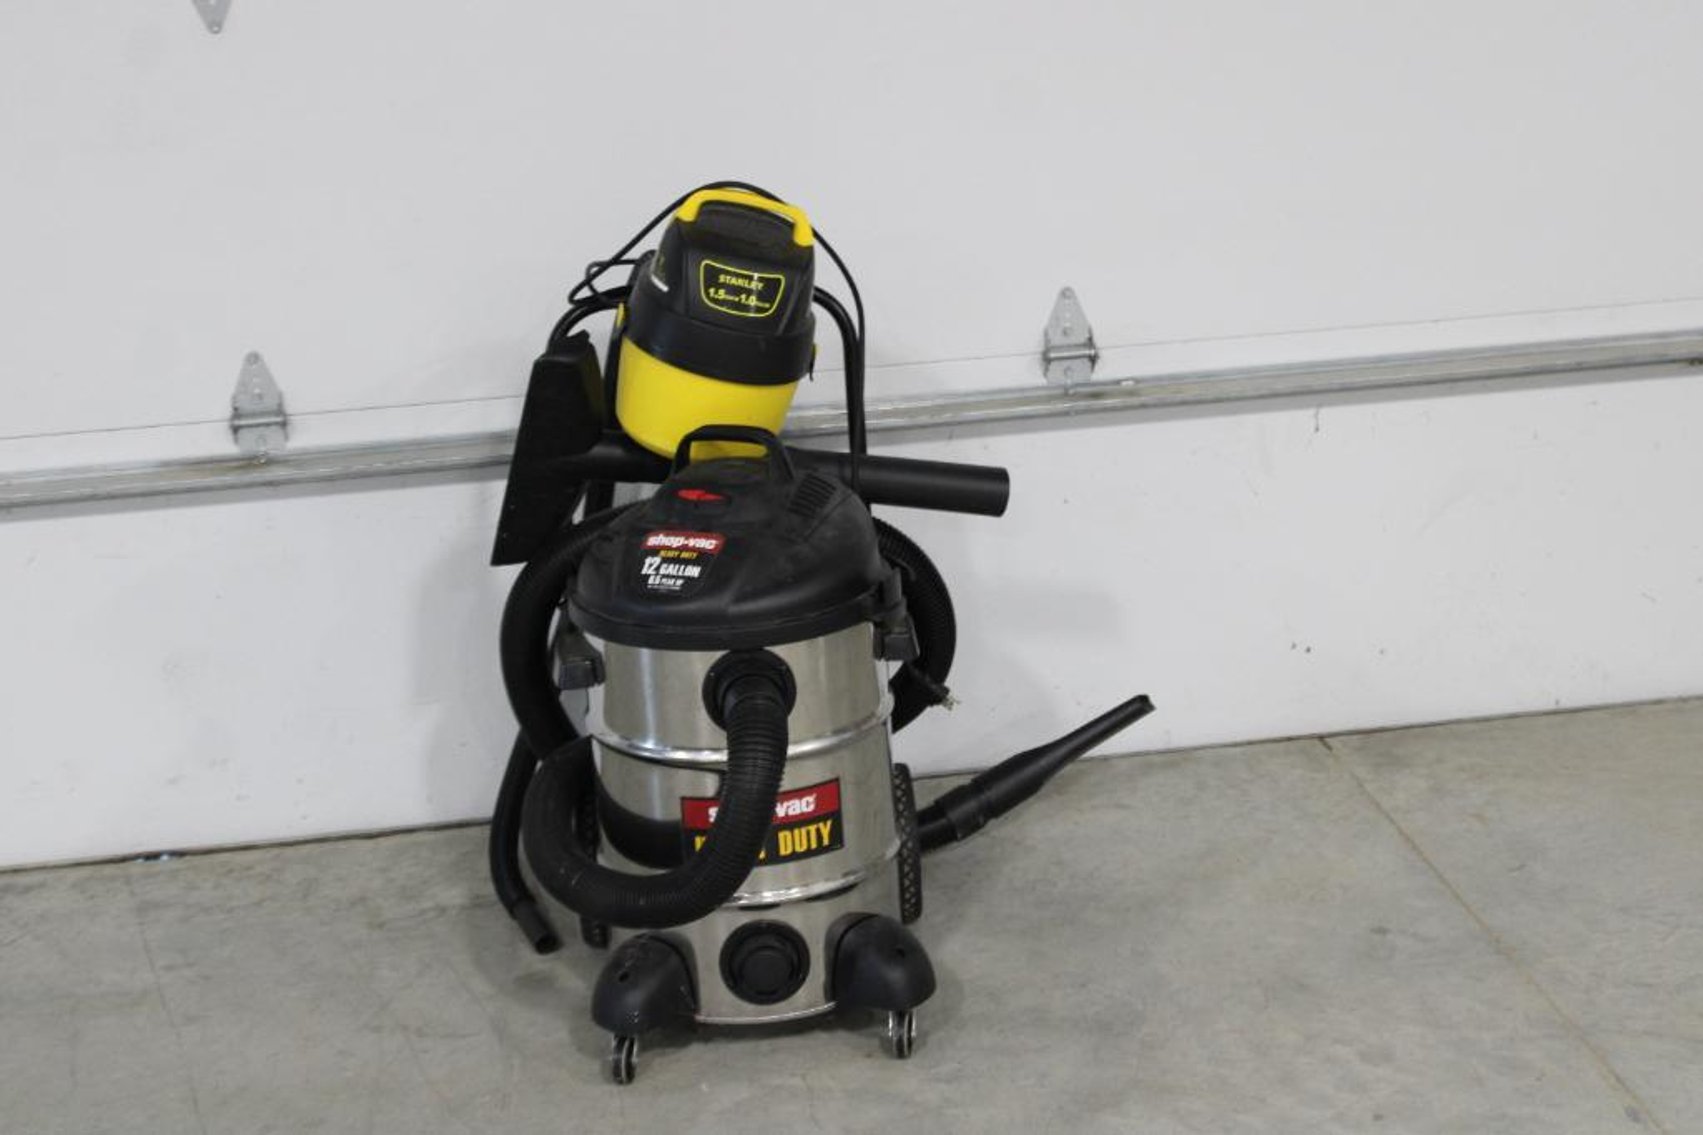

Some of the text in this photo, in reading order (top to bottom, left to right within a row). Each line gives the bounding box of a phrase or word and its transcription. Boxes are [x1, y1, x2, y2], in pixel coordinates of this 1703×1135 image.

[719, 274, 763, 290] STANLEY
[708, 287, 726, 300] 1.5
[740, 293, 757, 306] 1.0
[647, 534, 717, 549] shop-vac
[641, 556, 701, 577] 12 GALLON
[778, 820, 832, 856] DUTY
